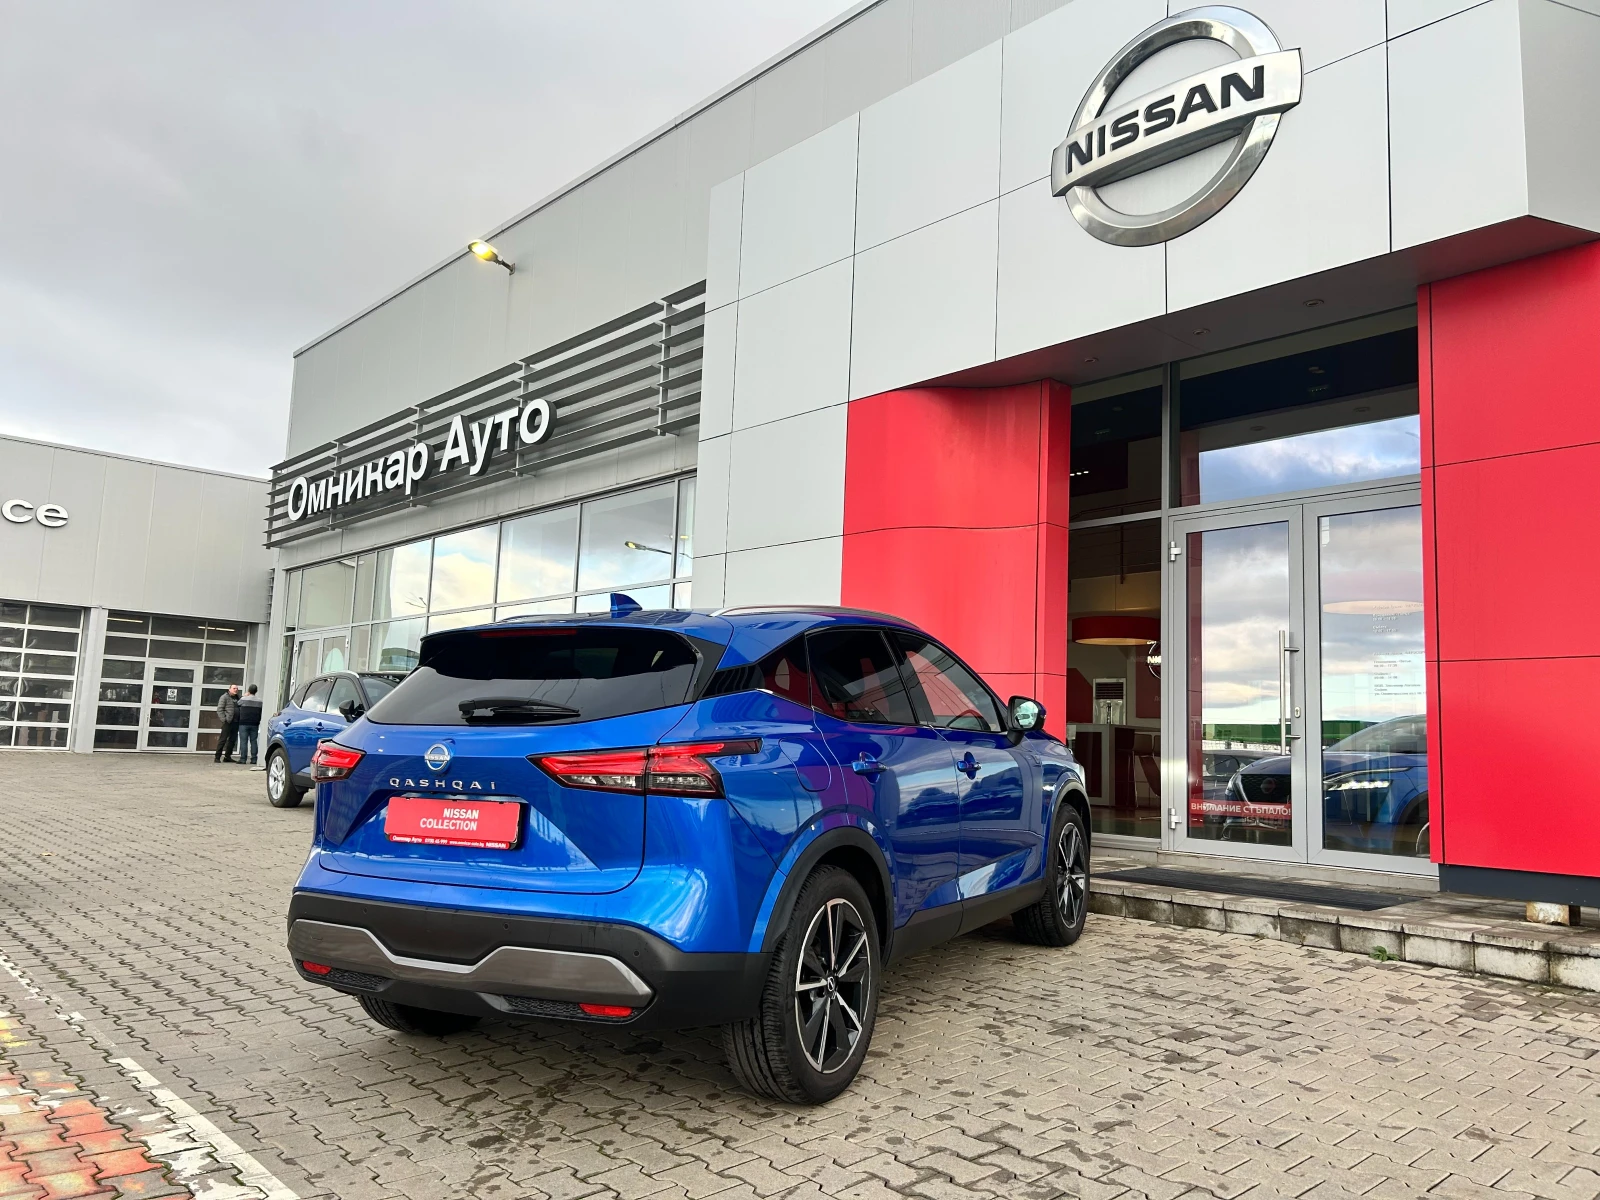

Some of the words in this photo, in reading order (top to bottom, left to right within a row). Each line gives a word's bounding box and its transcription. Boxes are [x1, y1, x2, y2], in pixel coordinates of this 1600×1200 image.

[1066, 65, 1264, 175] NISSAN
[288, 443, 431, 521] Омникар
[439, 399, 554, 476] Ауто
[1, 499, 69, 528] ce
[443, 808, 479, 819] NISSAN
[1191, 802, 1241, 813] ВНИМАНИЕ
[1243, 805, 1292, 816] СТЪПАЛО!
[420, 818, 477, 831] COLLECTION
